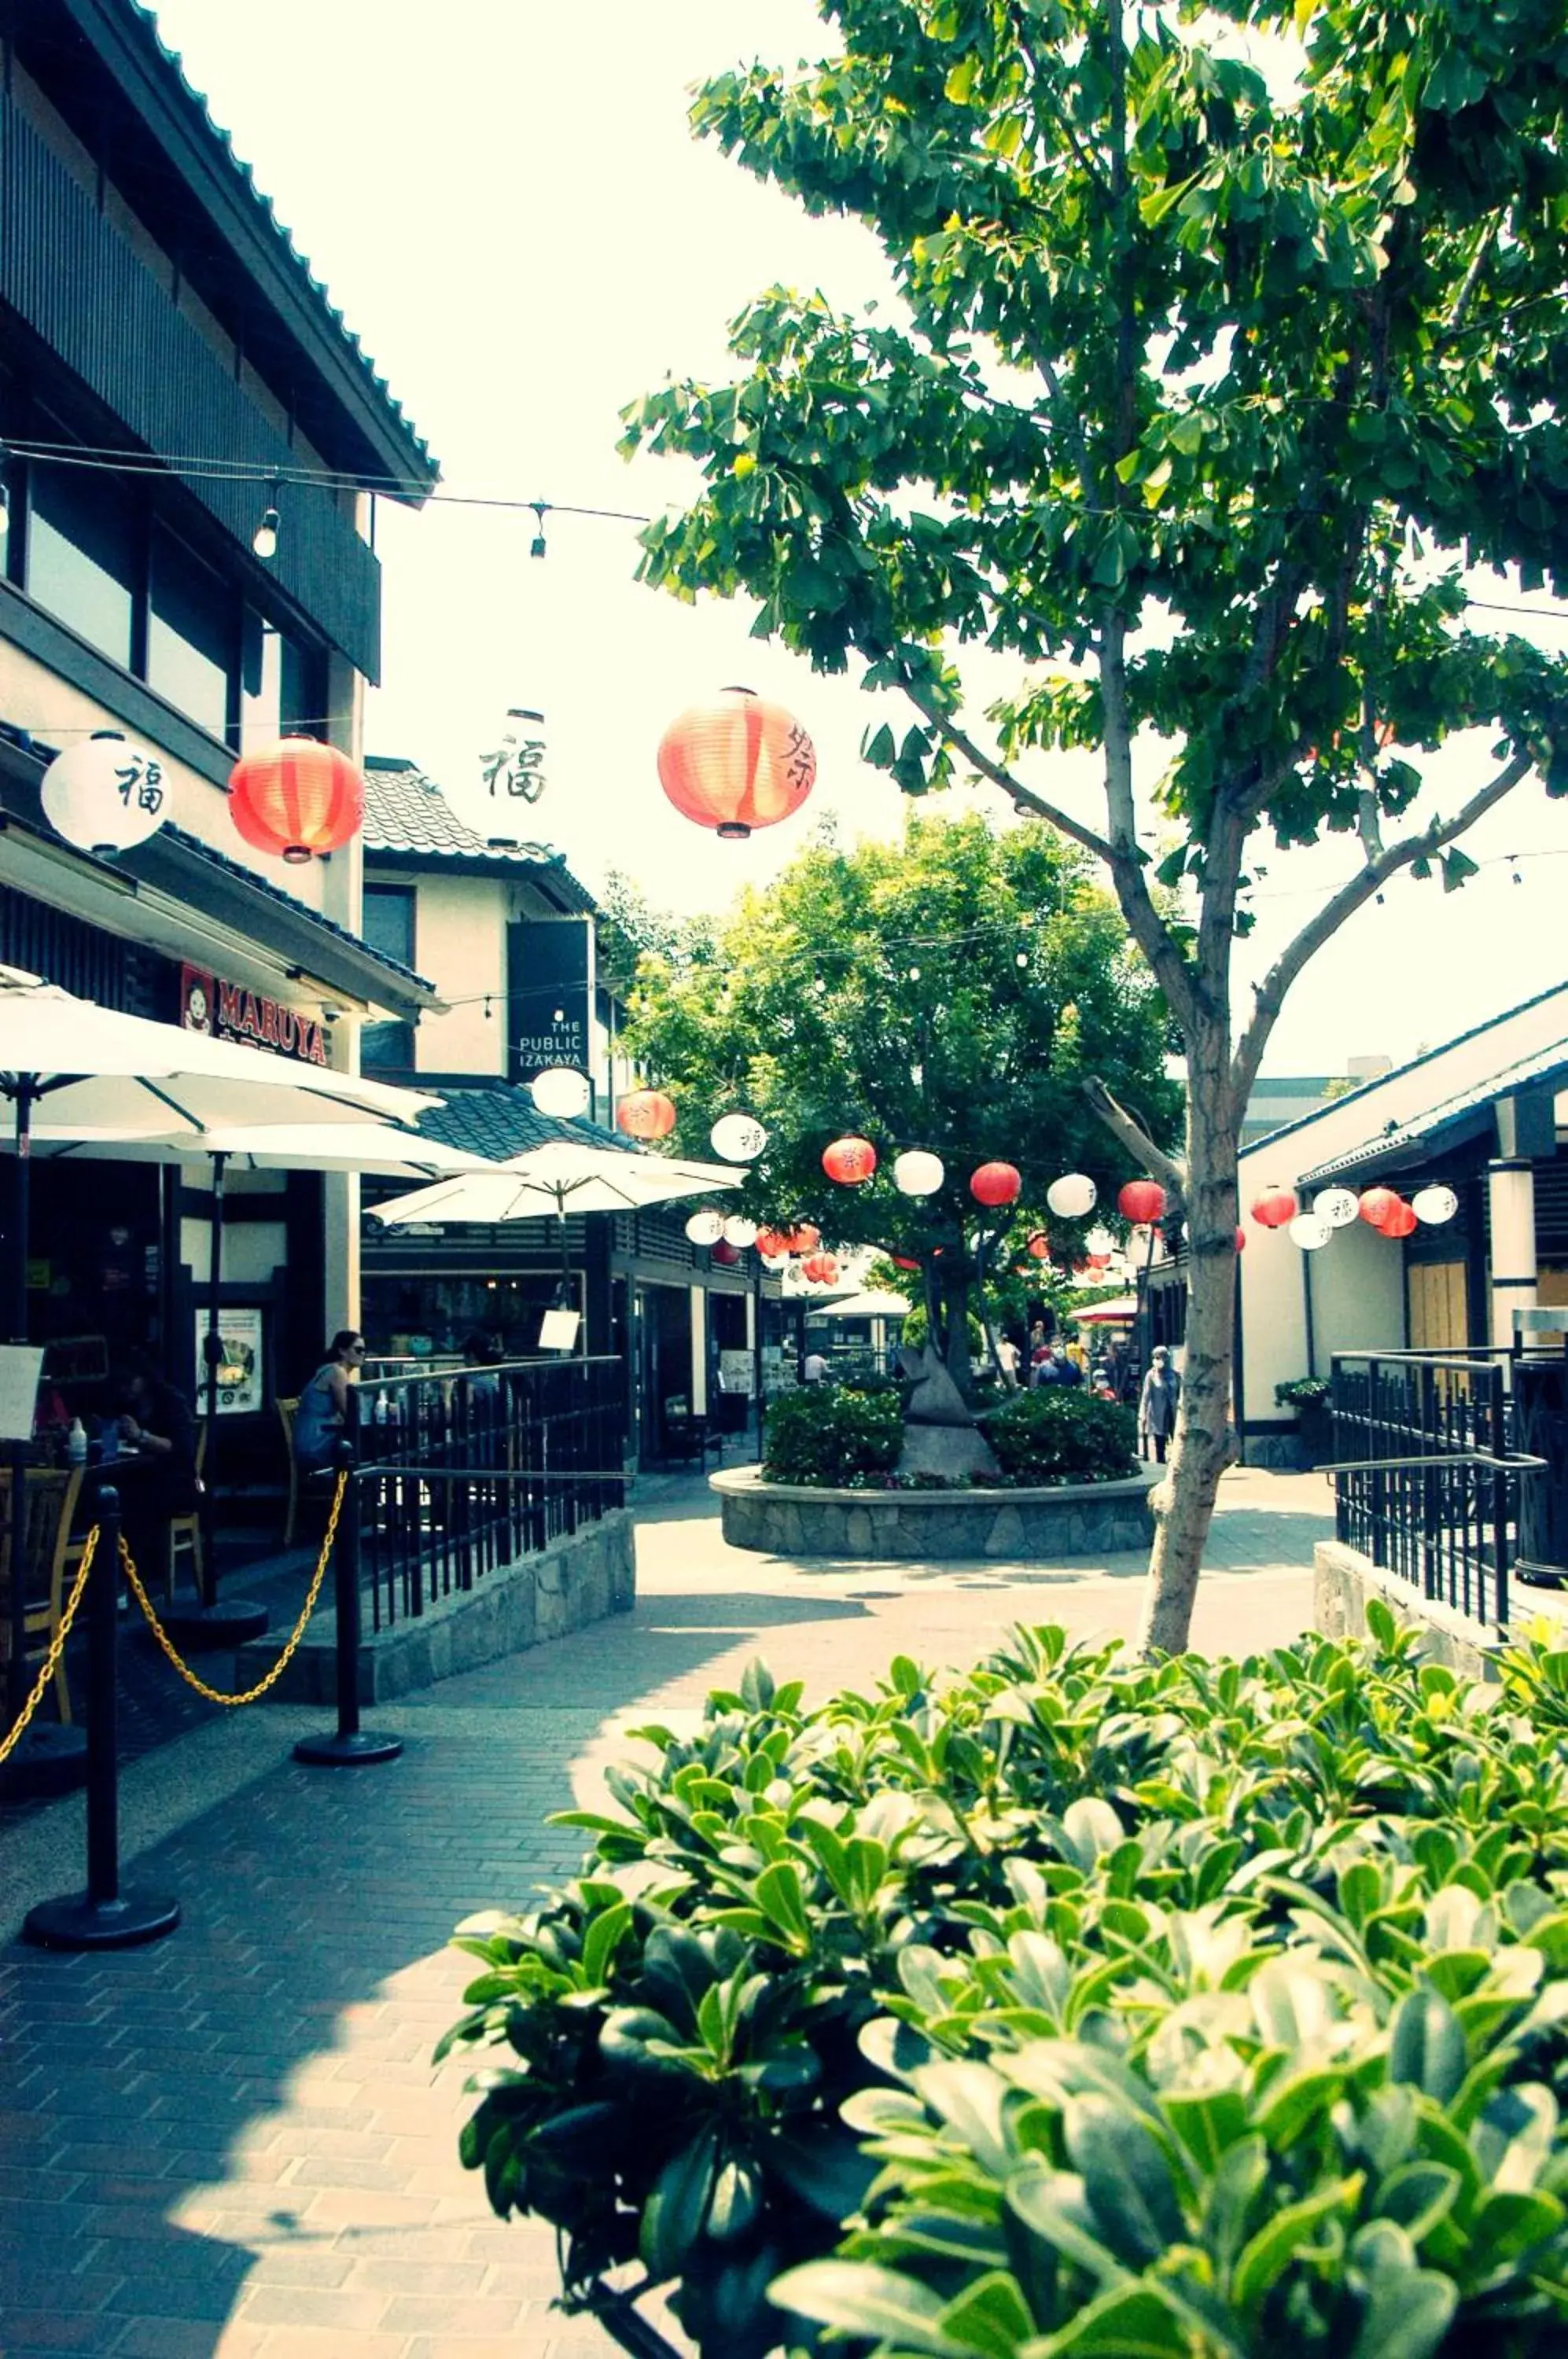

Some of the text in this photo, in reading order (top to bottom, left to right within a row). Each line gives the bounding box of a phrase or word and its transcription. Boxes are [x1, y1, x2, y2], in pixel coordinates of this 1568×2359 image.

[114, 754, 164, 815] 福
[478, 733, 547, 804] 福
[219, 979, 327, 1065] MARUYA
[551, 1021, 580, 1032] THE
[520, 1036, 581, 1051] PUBLIC
[520, 1054, 580, 1067] IZAKAYA
